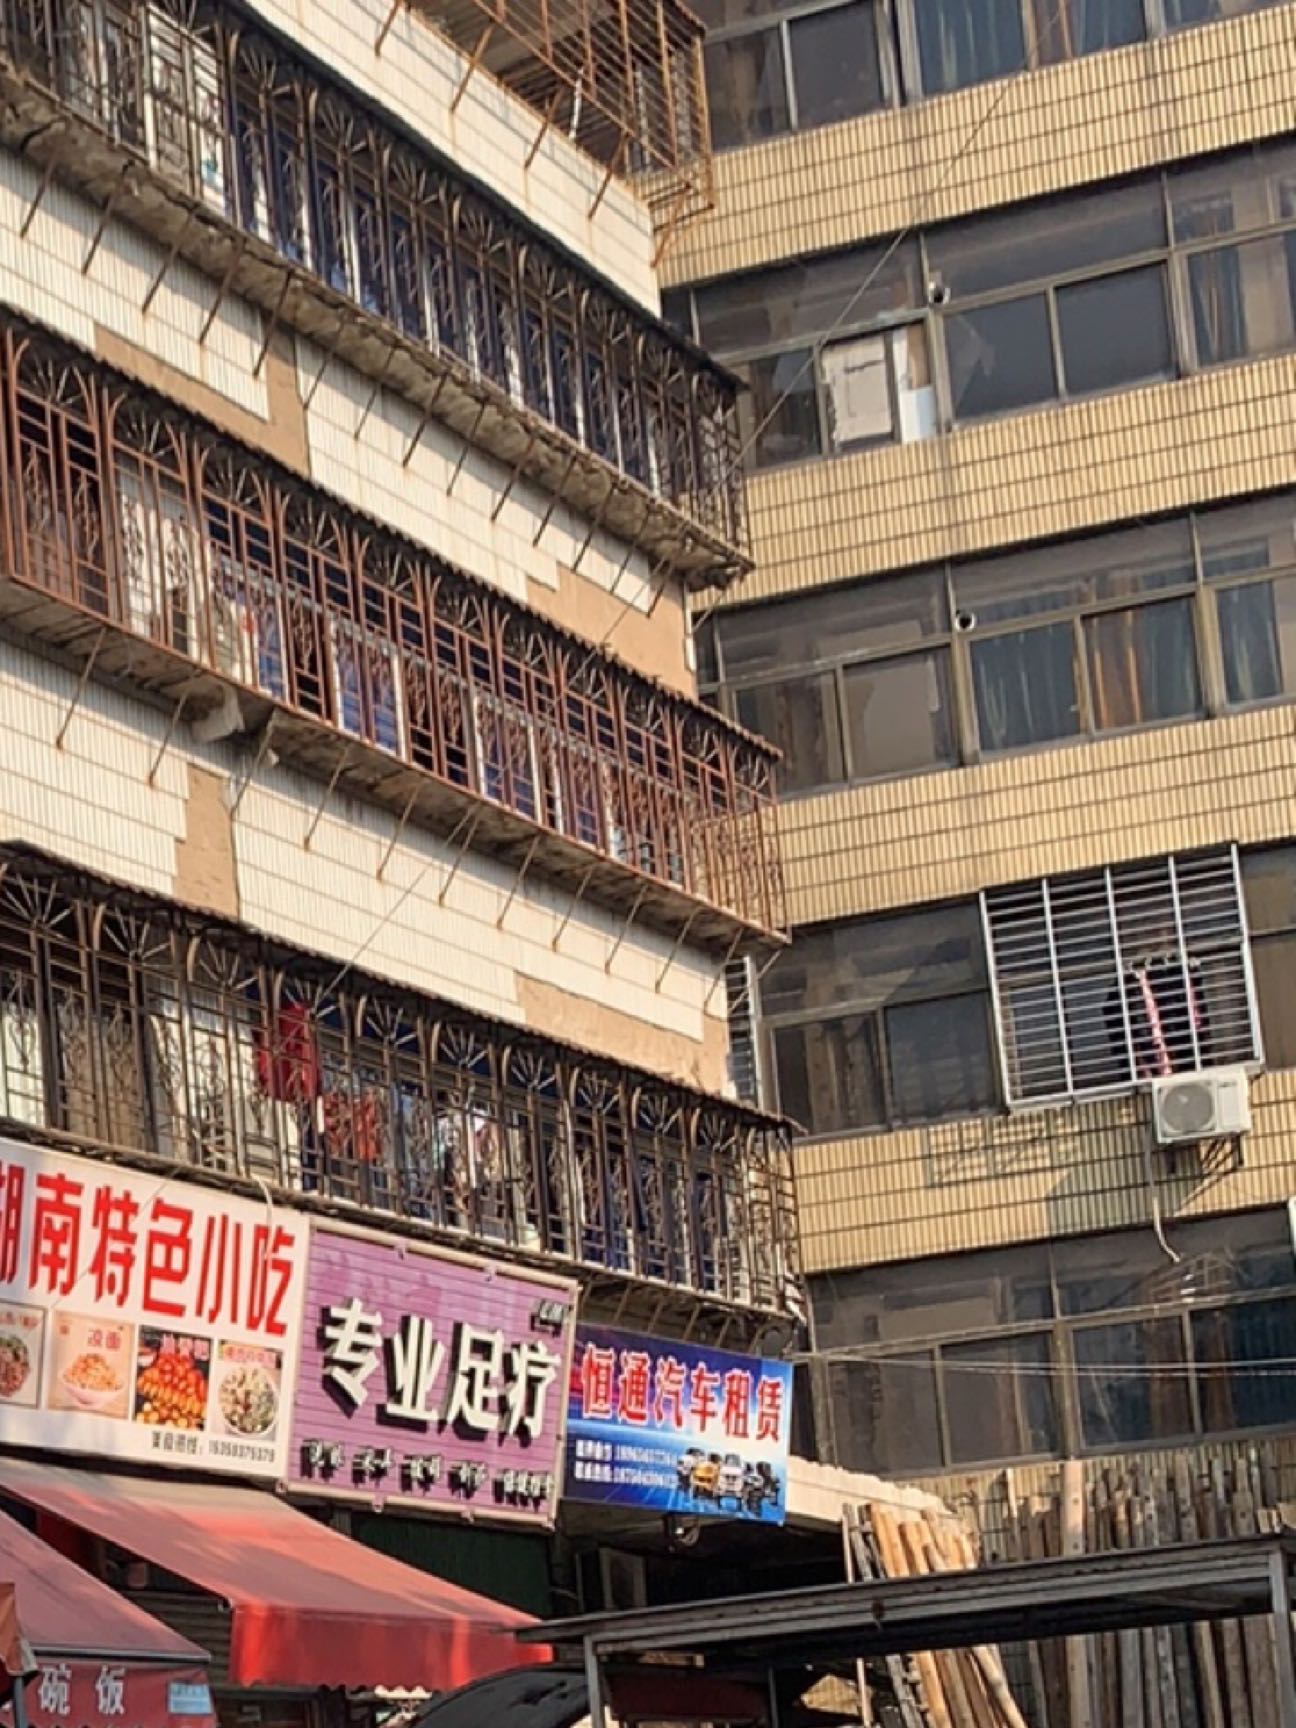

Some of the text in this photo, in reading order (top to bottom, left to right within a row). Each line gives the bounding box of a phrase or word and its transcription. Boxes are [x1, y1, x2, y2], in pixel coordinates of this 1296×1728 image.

[322, 1298, 561, 1440] 专业足疗
[580, 1341, 785, 1445] 恒通汽车租赁
